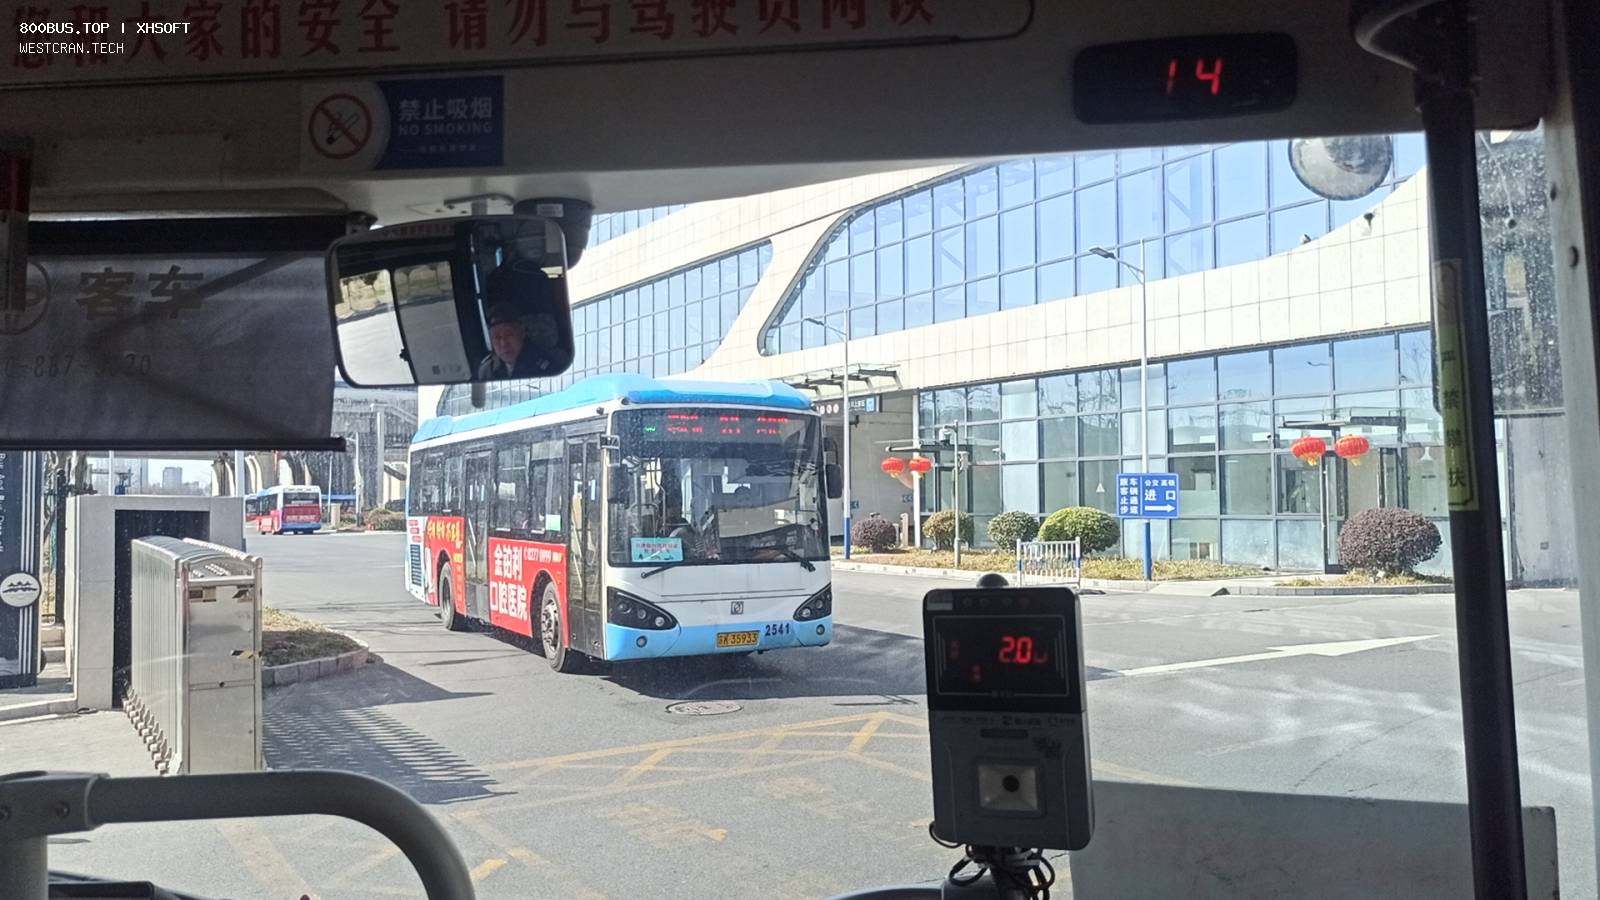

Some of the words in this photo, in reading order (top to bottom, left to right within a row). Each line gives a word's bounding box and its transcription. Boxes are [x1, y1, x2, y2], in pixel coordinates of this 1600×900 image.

[1166, 57, 1225, 95] 14
[399, 97, 492, 121] 禁止吸烟
[400, 124, 420, 136] NO
[424, 122, 493, 135] SMOKING
[75, 265, 204, 320] 客车
[1144, 489, 1176, 501] 进口
[490, 580, 528, 620] 口腔医院
[764, 623, 790, 637] 2541
